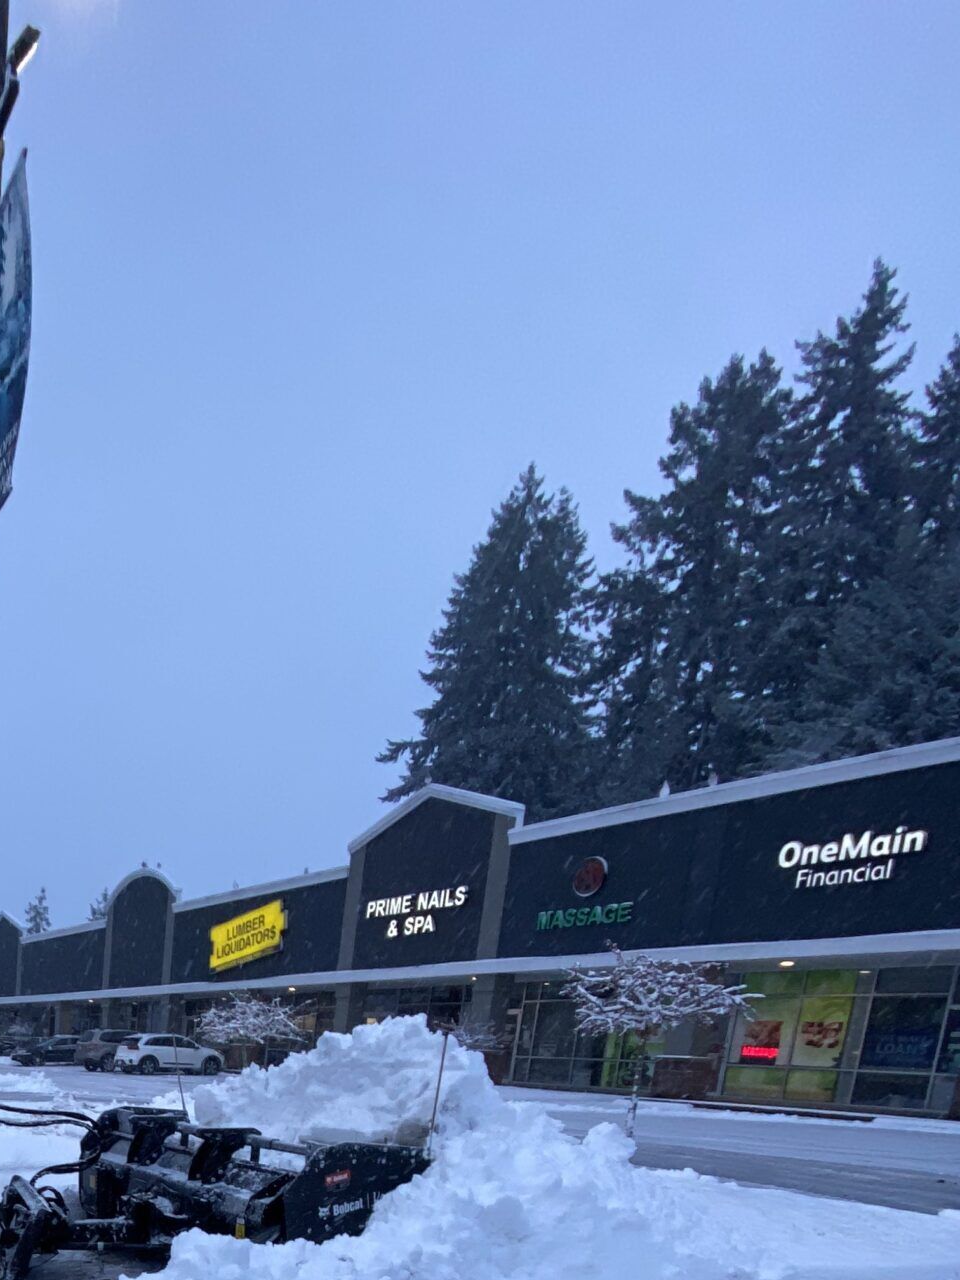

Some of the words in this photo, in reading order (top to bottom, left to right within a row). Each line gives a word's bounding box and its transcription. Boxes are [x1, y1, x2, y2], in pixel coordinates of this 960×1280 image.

[778, 825, 928, 868] OneMain
[795, 858, 894, 889] Financial
[365, 893, 414, 918] PRIME
[417, 885, 469, 911] NAILS
[536, 901, 634, 930] MASSAGE
[226, 914, 265, 941] LUMBER
[386, 918, 398, 937] &
[403, 914, 435, 935] SPA
[332, 1197, 364, 1217] Bobcat
